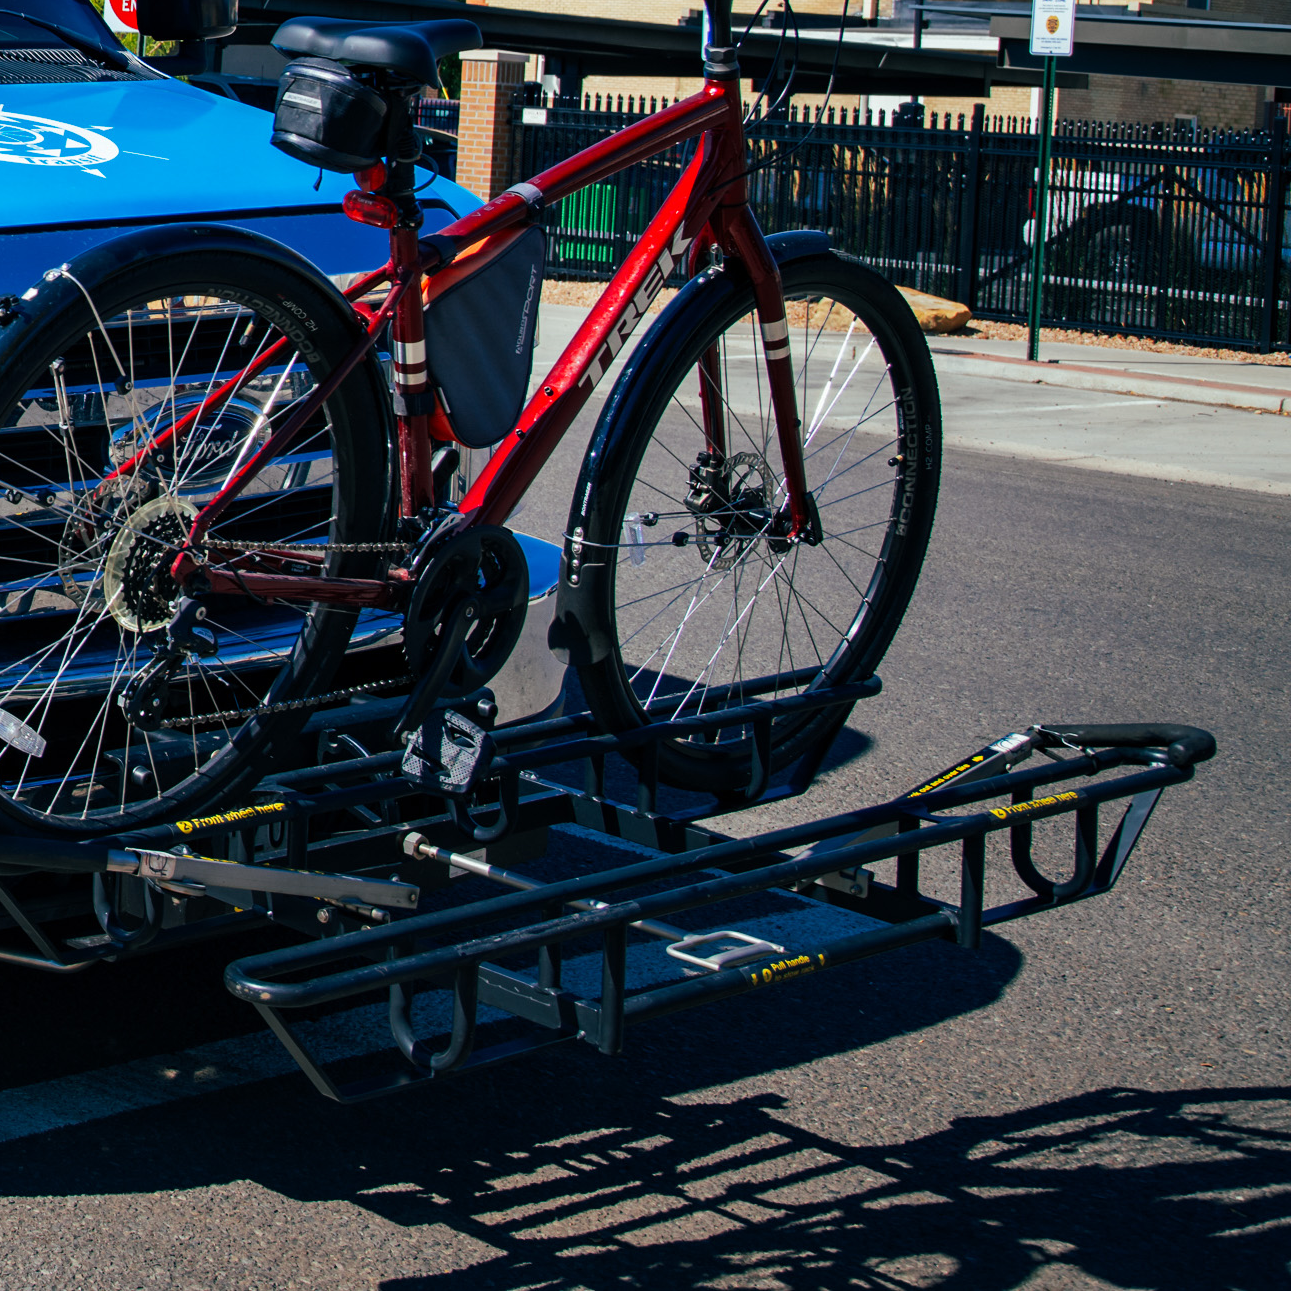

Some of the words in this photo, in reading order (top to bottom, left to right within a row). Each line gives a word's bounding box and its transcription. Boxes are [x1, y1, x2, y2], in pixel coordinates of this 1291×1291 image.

[578, 220, 693, 388] TREK
[173, 423, 239, 462] Ford
[191, 813, 225, 829] Front
[224, 806, 257, 821] wheel
[254, 802, 285, 815] here
[770, 960, 787, 972] Pull
[785, 955, 811, 967] handle
